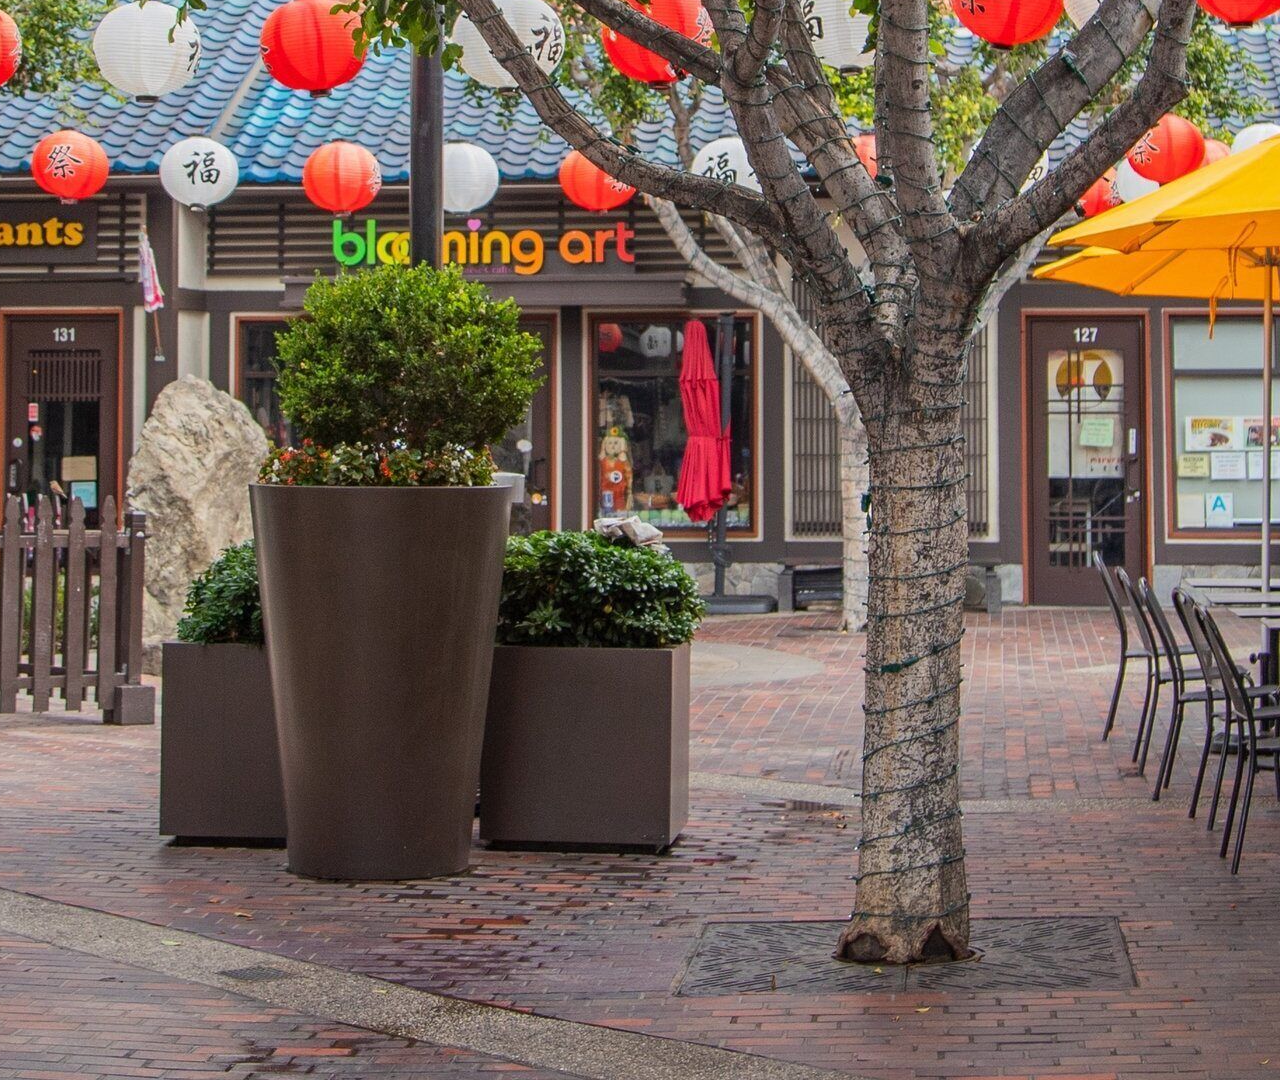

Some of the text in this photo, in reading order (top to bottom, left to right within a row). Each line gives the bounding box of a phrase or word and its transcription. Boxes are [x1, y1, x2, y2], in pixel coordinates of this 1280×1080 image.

[531, 15, 565, 67] 福
[44, 143, 83, 179] 祭
[183, 150, 220, 186] 福
[558, 222, 635, 264] art
[52, 327, 76, 342] 131
[1073, 327, 1099, 343] 127
[1212, 495, 1226, 511] A
